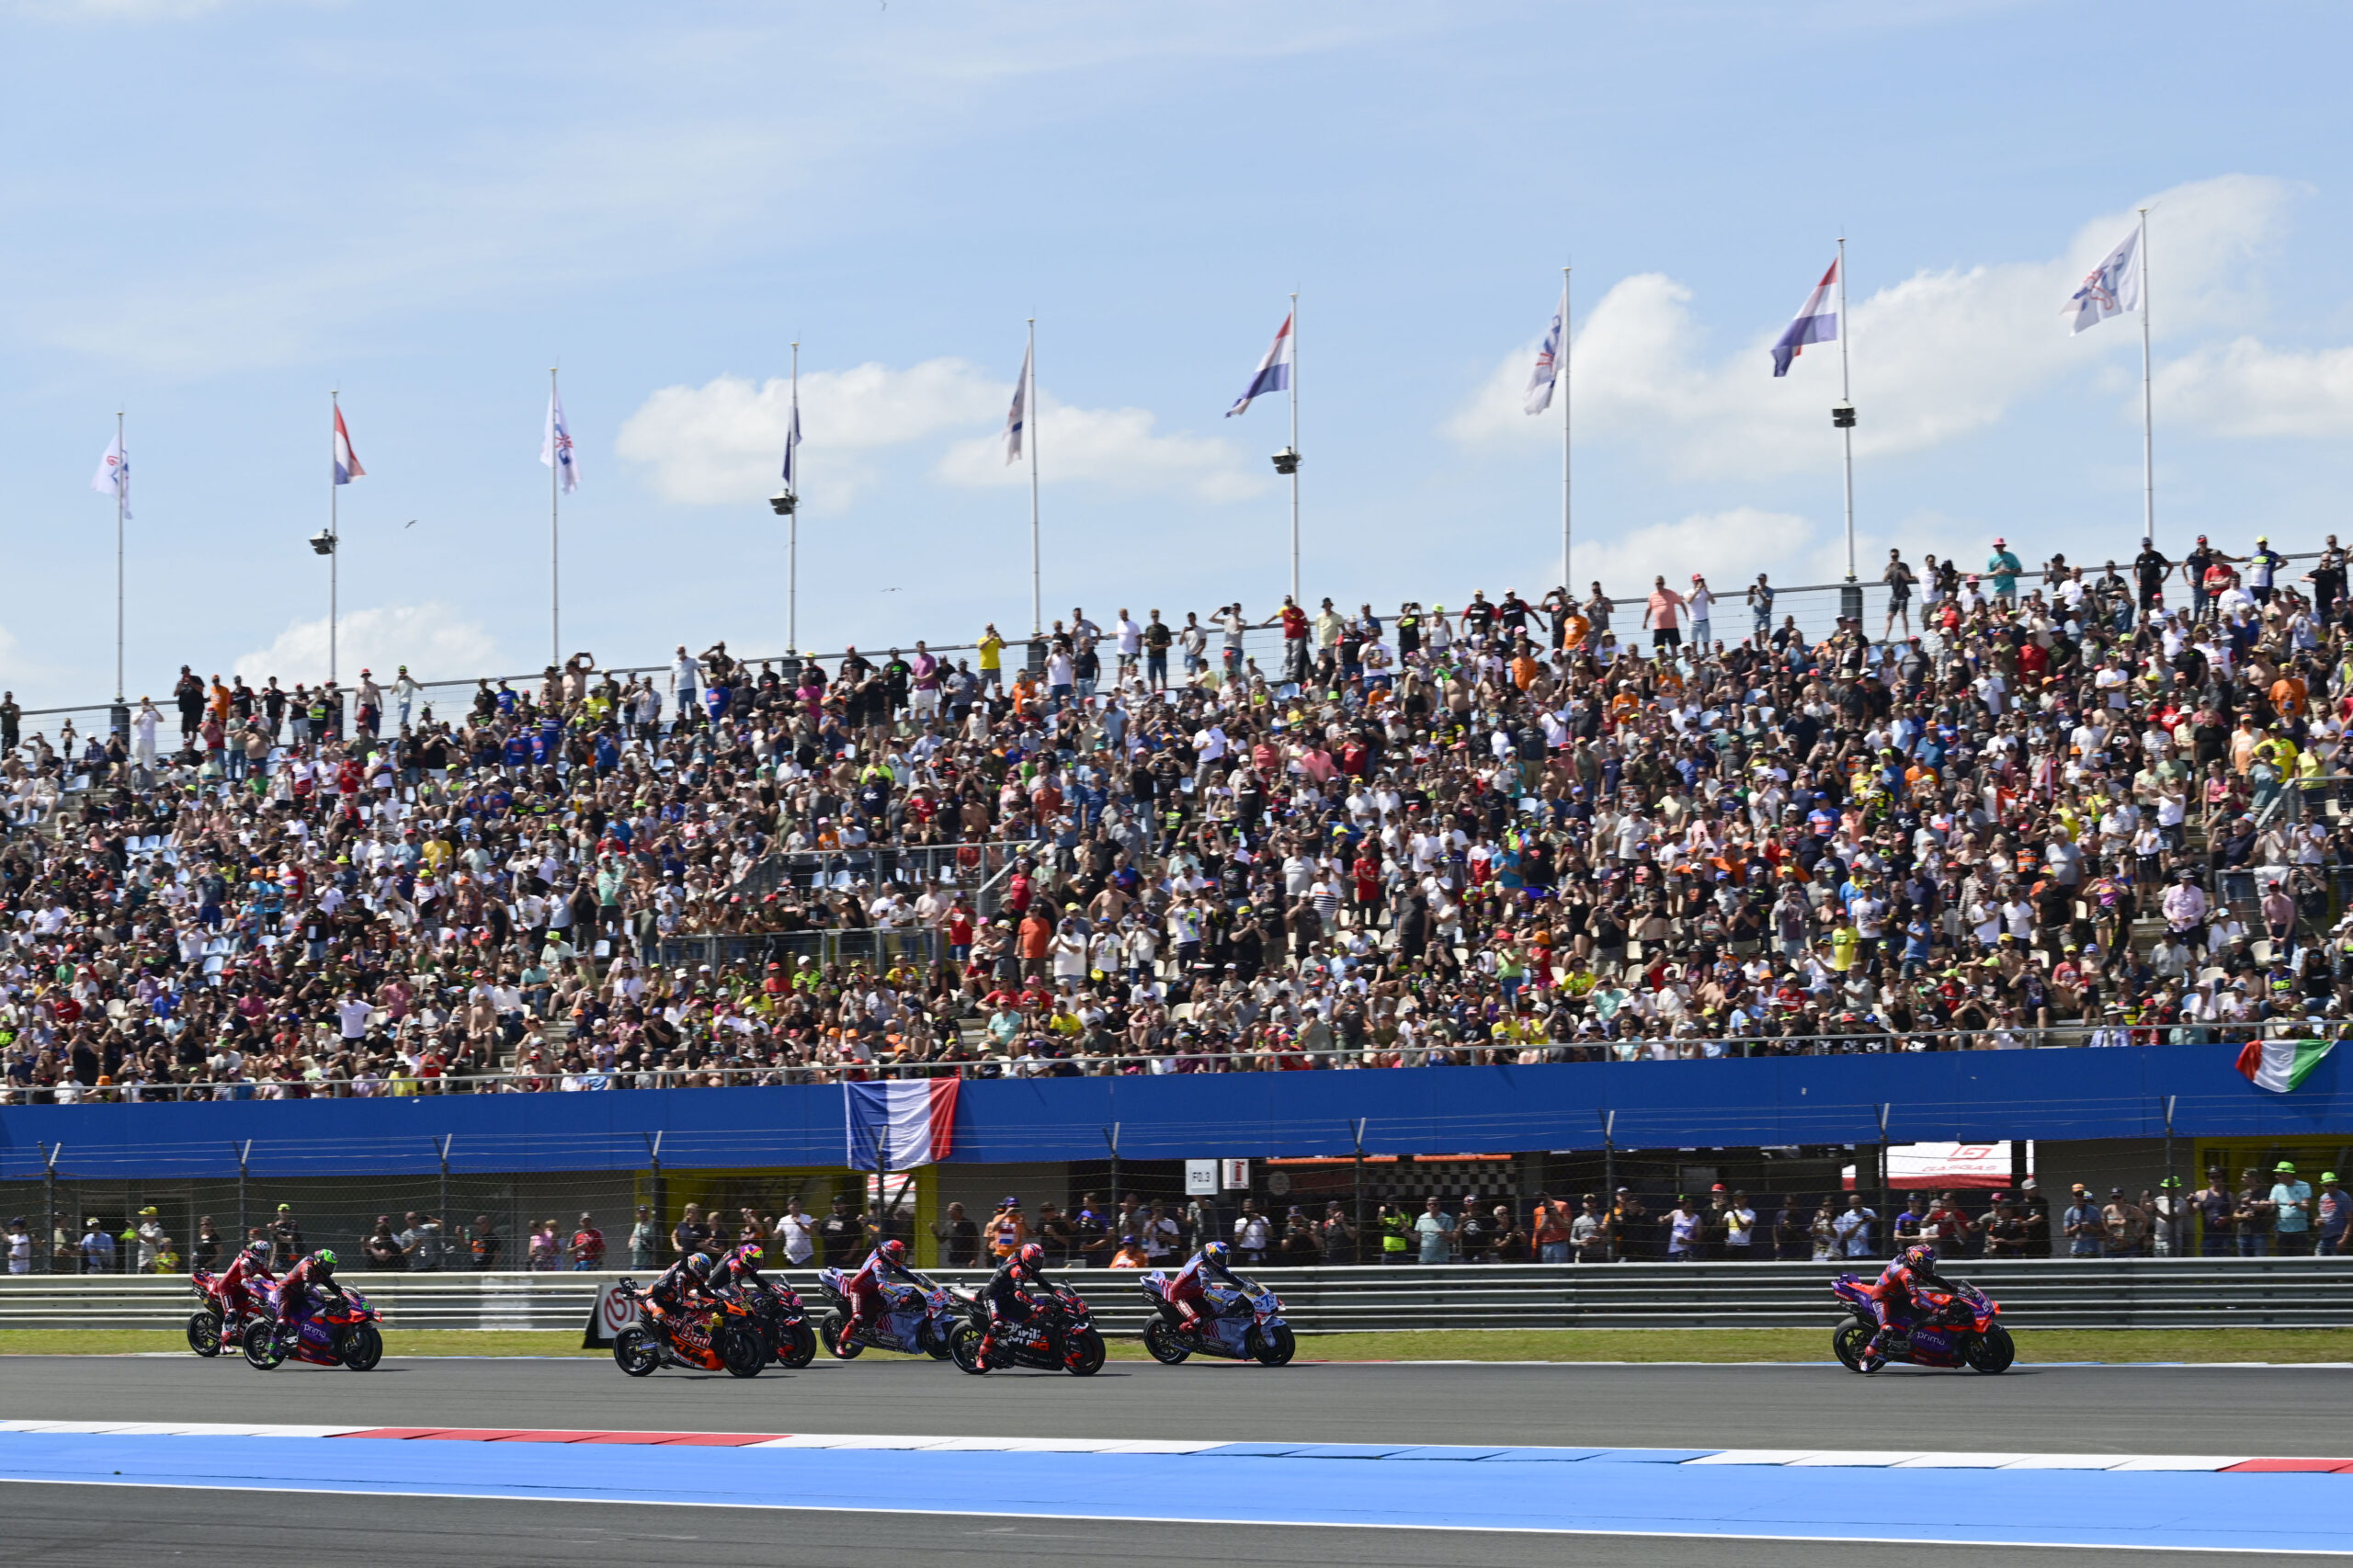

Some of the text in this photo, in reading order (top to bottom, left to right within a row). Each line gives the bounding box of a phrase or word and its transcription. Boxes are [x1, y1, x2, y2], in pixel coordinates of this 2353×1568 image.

[1921, 1164, 1998, 1173] GASGAS
[303, 1324, 326, 1338] prima
[664, 1313, 712, 1350] ed Bull
[1916, 1331, 1946, 1346] prima
